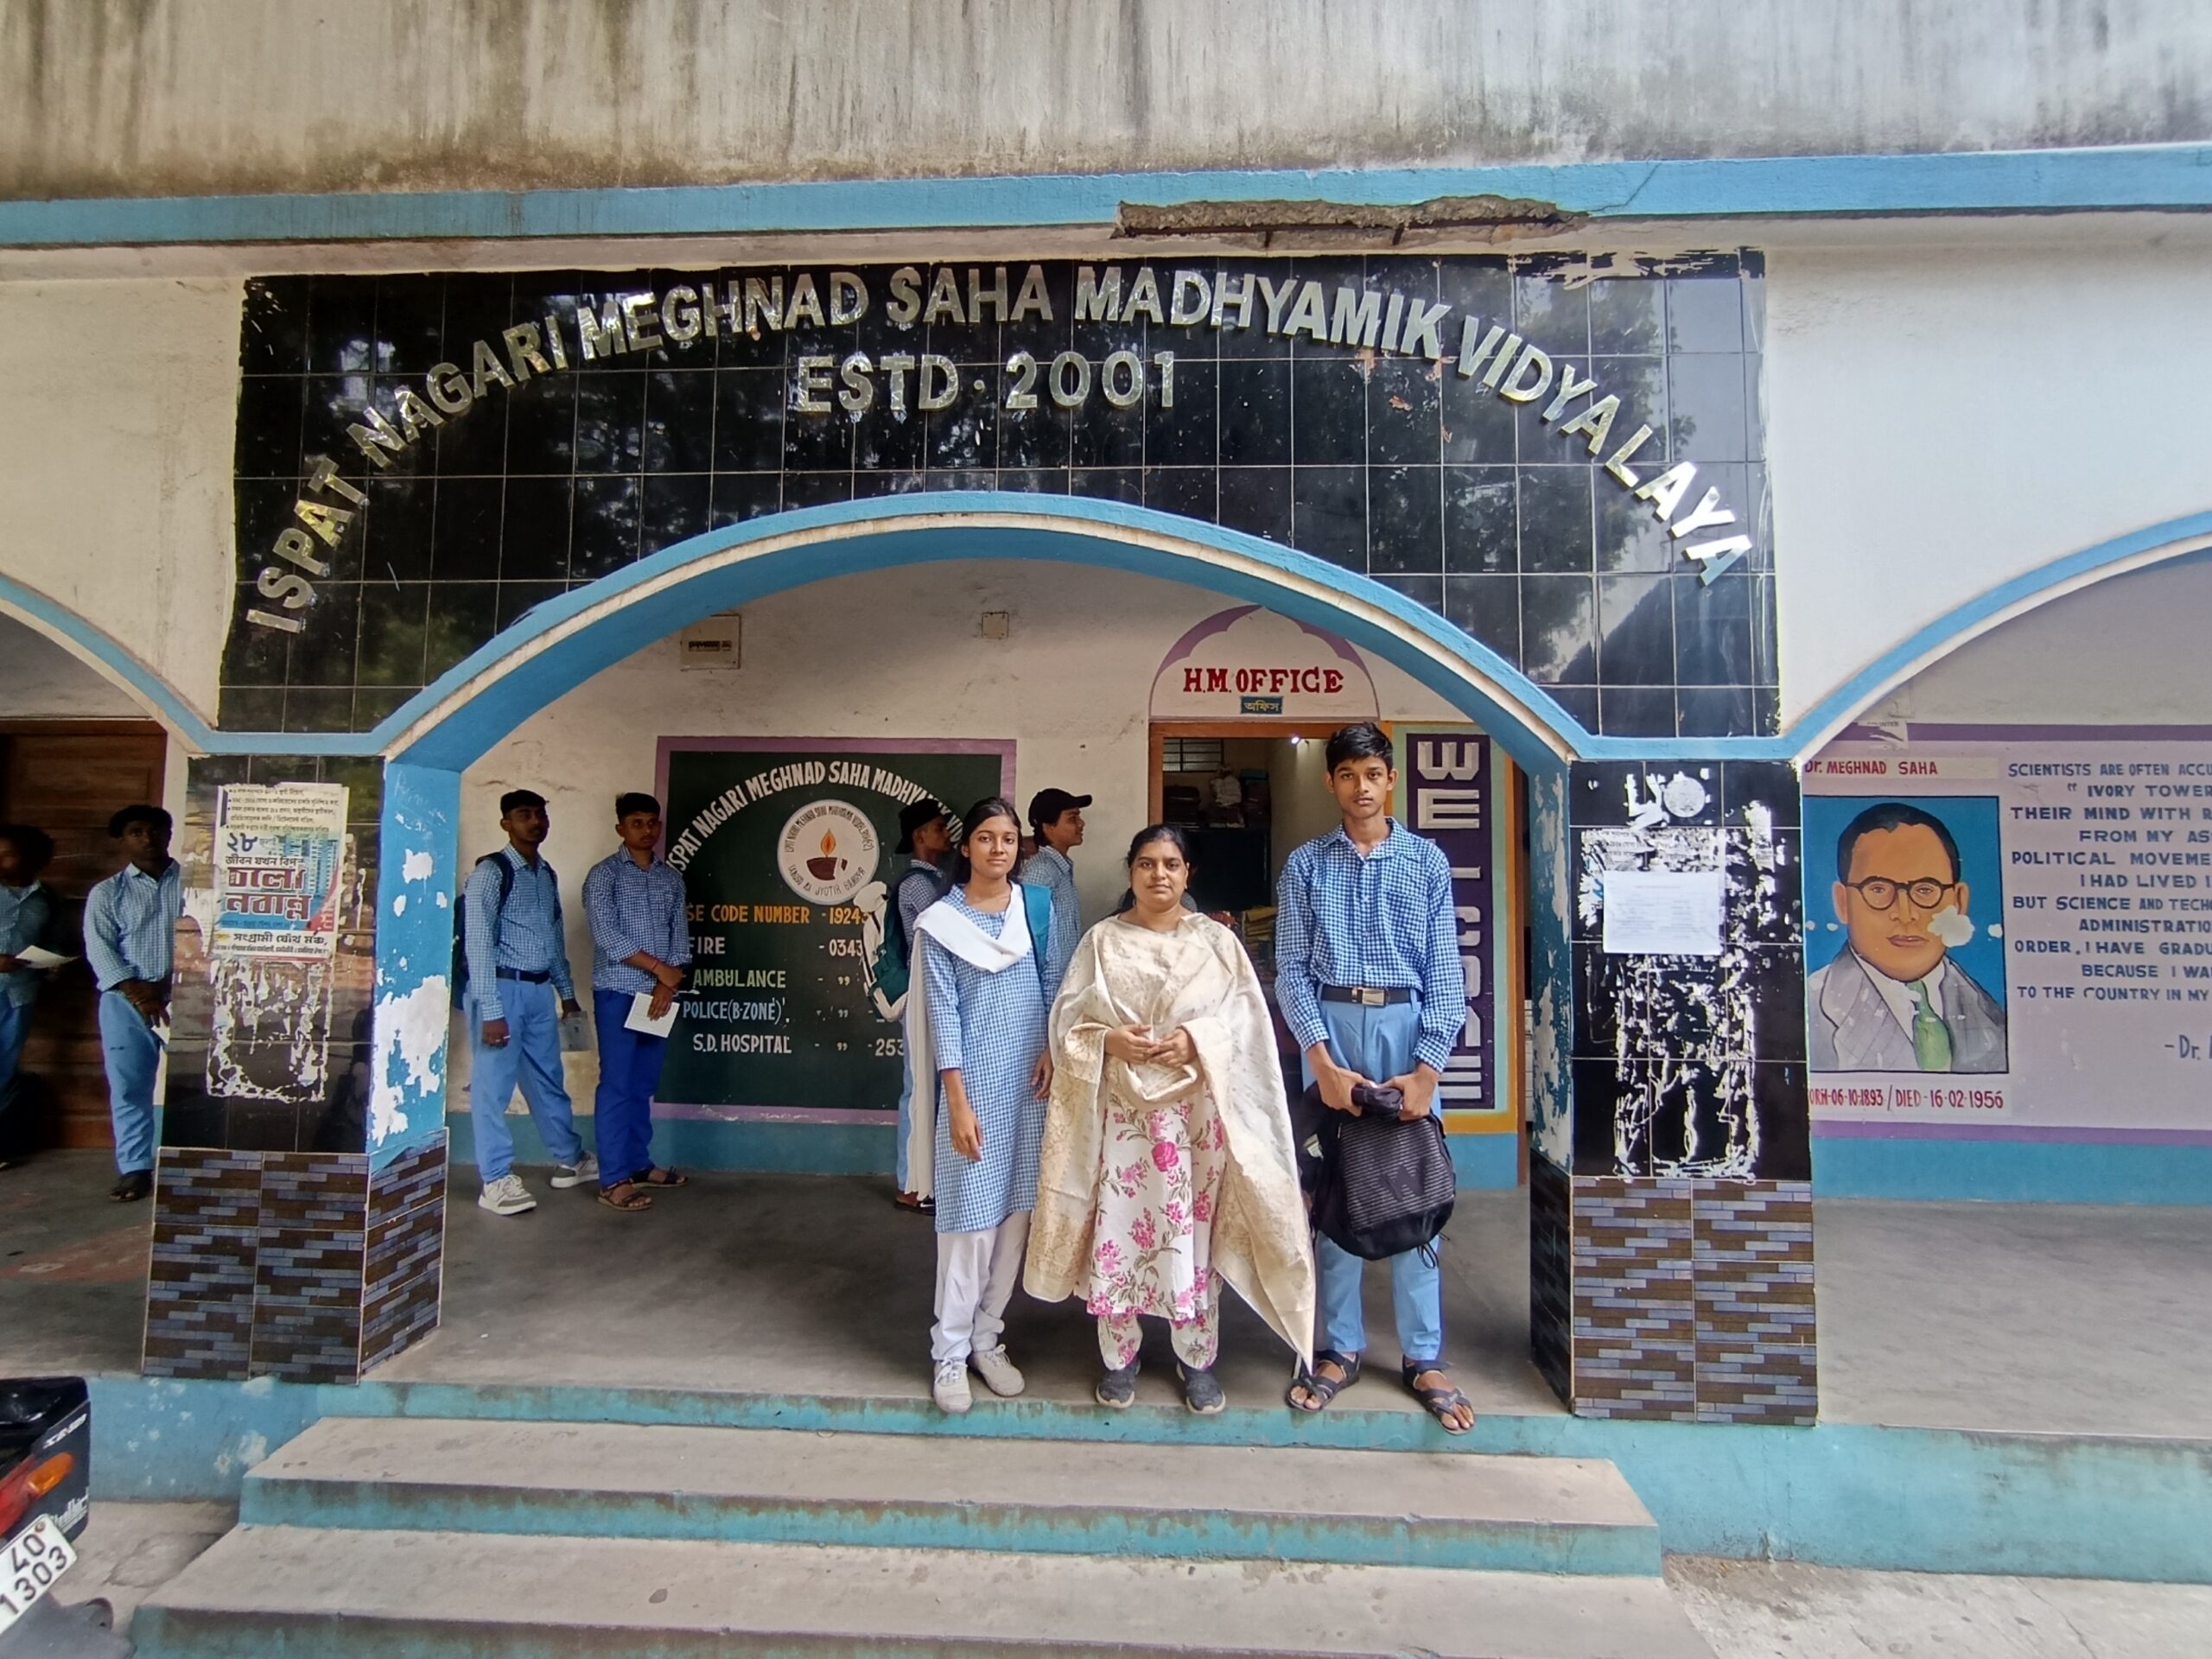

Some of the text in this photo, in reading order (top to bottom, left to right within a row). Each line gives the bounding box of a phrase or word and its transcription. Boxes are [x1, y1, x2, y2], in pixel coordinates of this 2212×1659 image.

[1006, 351, 1175, 410] 2001
[246, 264, 1751, 633] ISPAT NAGARI MEGHNAD SAHA MADHYAMIK VIDYALAYA
[1236, 666, 1344, 694] OFFICE
[1827, 760, 1887, 774] MEGHNAD
[1898, 761, 1938, 775] SAHA
[2008, 763, 2091, 777] SCIENTISTS
[2100, 764, 2124, 776] ARE
[2129, 764, 2170, 776] OFTEN
[692, 785, 748, 838] NAGARI
[745, 761, 826, 802] MEGHNAD
[829, 760, 871, 789] SAHA
[871, 767, 951, 815] MADHYA
[2088, 785, 2135, 798] IVORY
[2011, 807, 2072, 820] THEIR
[2084, 807, 2130, 820] MIND
[2139, 807, 2190, 820] WITH
[227, 832, 257, 852] ২৮
[2079, 830, 2212, 843] FROM MY AS
[226, 854, 251, 864] জীবন
[255, 855, 276, 865] যখন
[2012, 851, 2115, 865] POLITICAL
[227, 867, 305, 890] চলো
[2091, 874, 2127, 887] HAD
[2137, 874, 2196, 888] LIVED
[225, 892, 311, 920] নবান্ন
[2013, 896, 2047, 909] BUT
[2056, 896, 2130, 910] SCIENCE
[2139, 899, 2163, 910] AND
[711, 904, 748, 923] CODE
[753, 906, 810, 925] NUMBER
[233, 931, 273, 943] সংগ্রামী
[276, 932, 301, 944] যৌথ
[2095, 942, 2145, 954] HAVE
[693, 969, 786, 988] AMBULANCE
[2082, 964, 2158, 977] BECAUSE
[2183, 966, 2212, 978] WA
[2017, 986, 2037, 998] TO
[2043, 987, 2075, 998] THE
[2166, 989, 2181, 1000] IN
[2188, 989, 2209, 1001] MY
[721, 1033, 792, 1053] HOSPITAL
